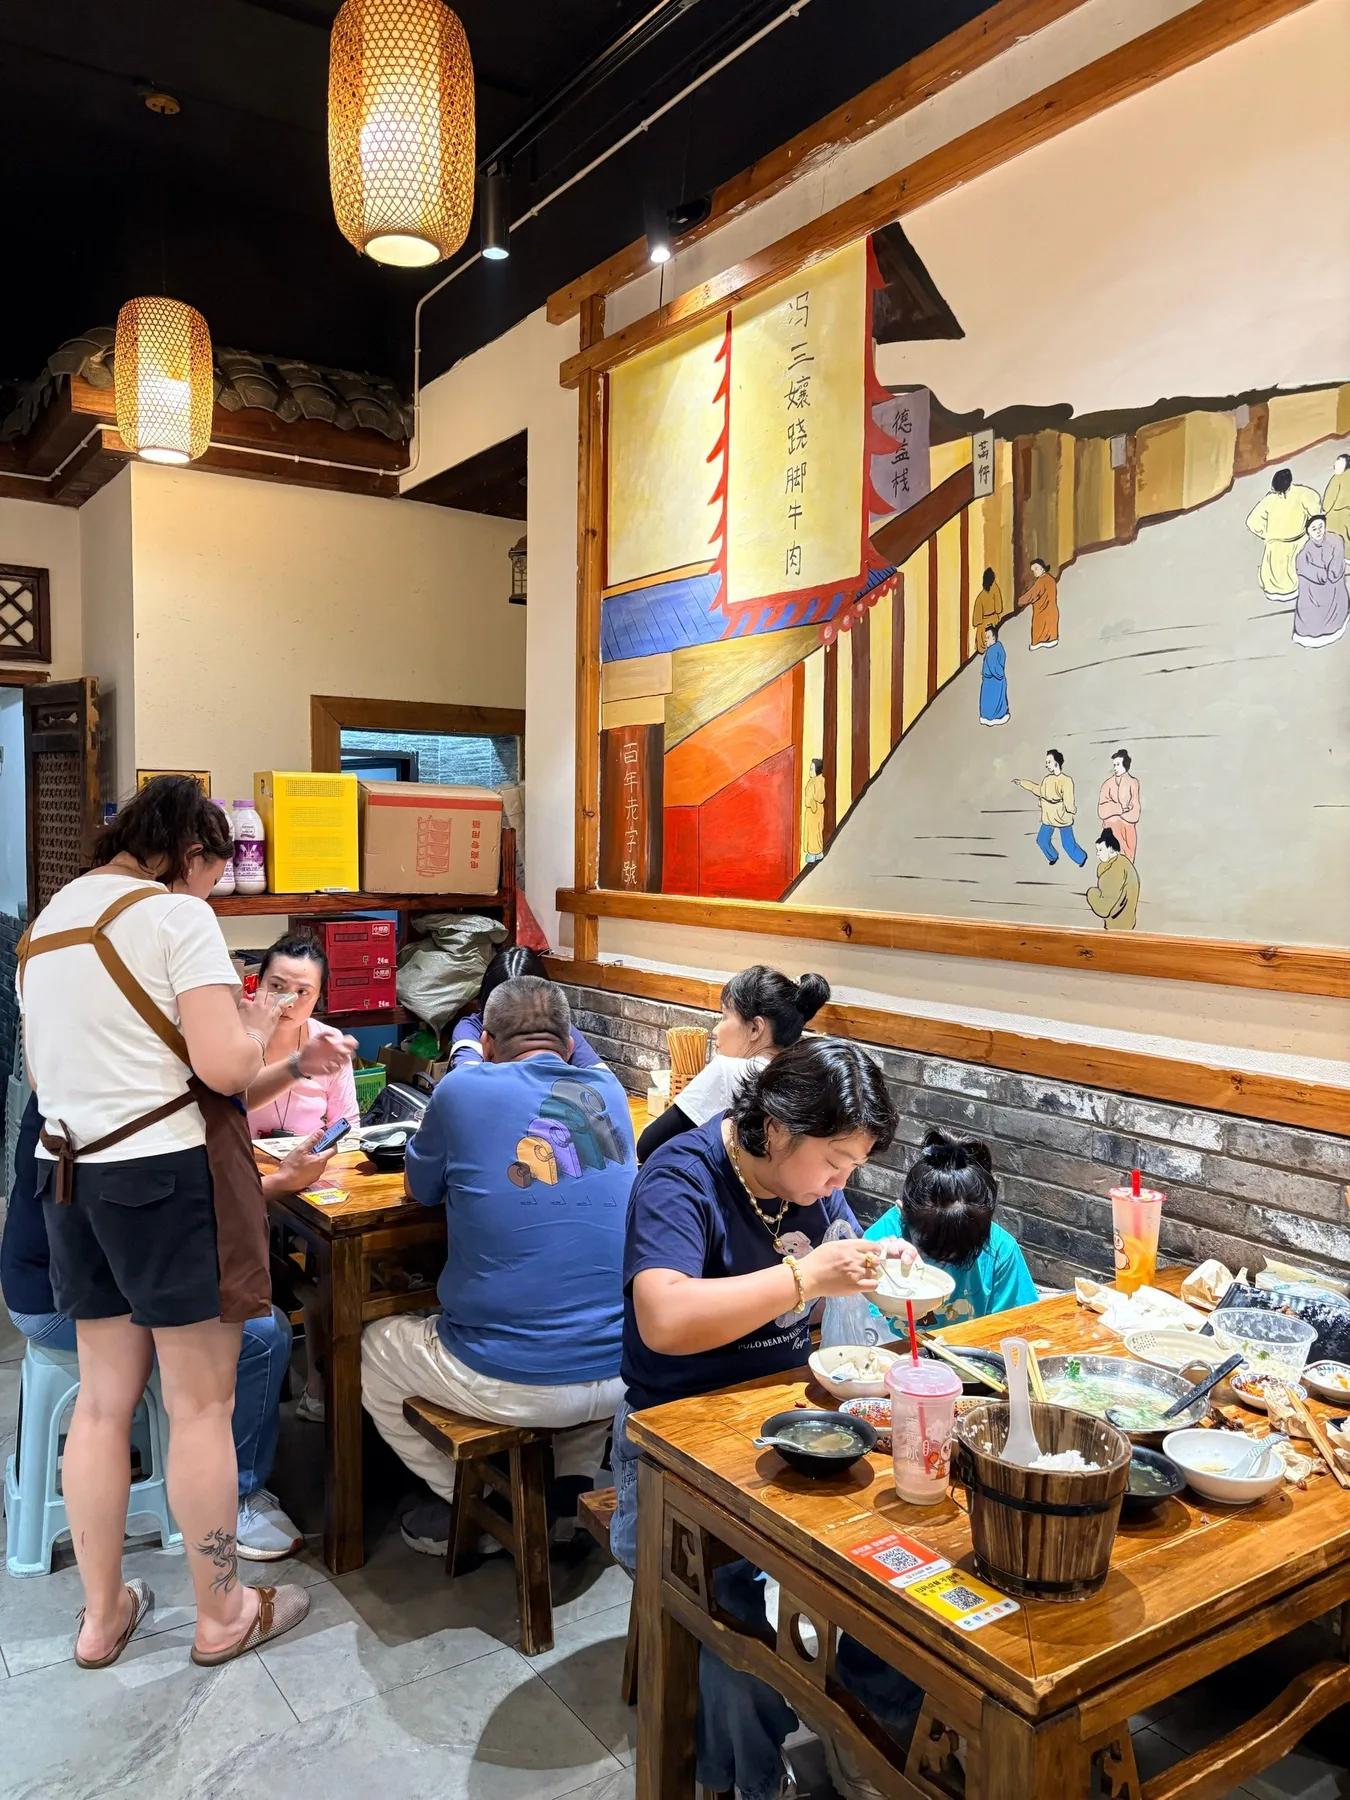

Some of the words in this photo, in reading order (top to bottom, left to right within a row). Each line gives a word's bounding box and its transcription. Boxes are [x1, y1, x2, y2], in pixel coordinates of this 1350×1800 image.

[622, 742, 639, 885] 百年老字號
[762, 1336, 782, 1347] BEAR
